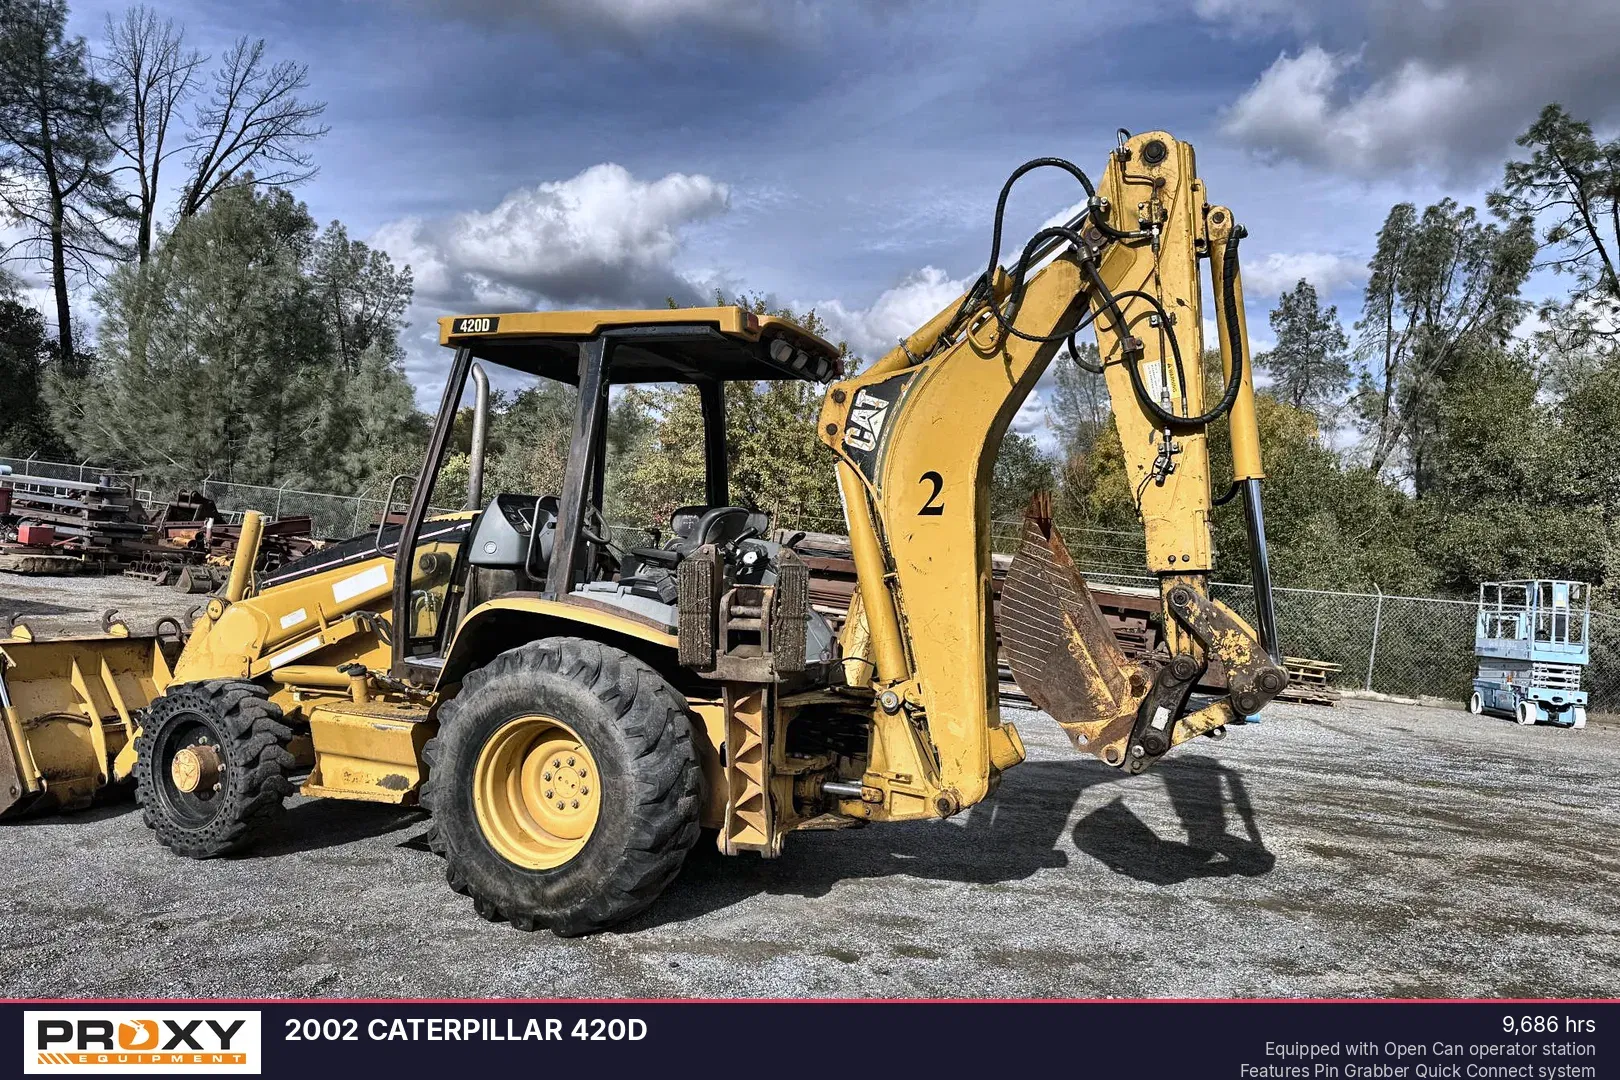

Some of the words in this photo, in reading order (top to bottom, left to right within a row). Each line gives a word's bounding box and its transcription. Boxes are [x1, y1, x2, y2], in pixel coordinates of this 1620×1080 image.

[460, 318, 490, 332] 420D
[844, 389, 890, 451] CAT
[917, 470, 945, 516] 2
